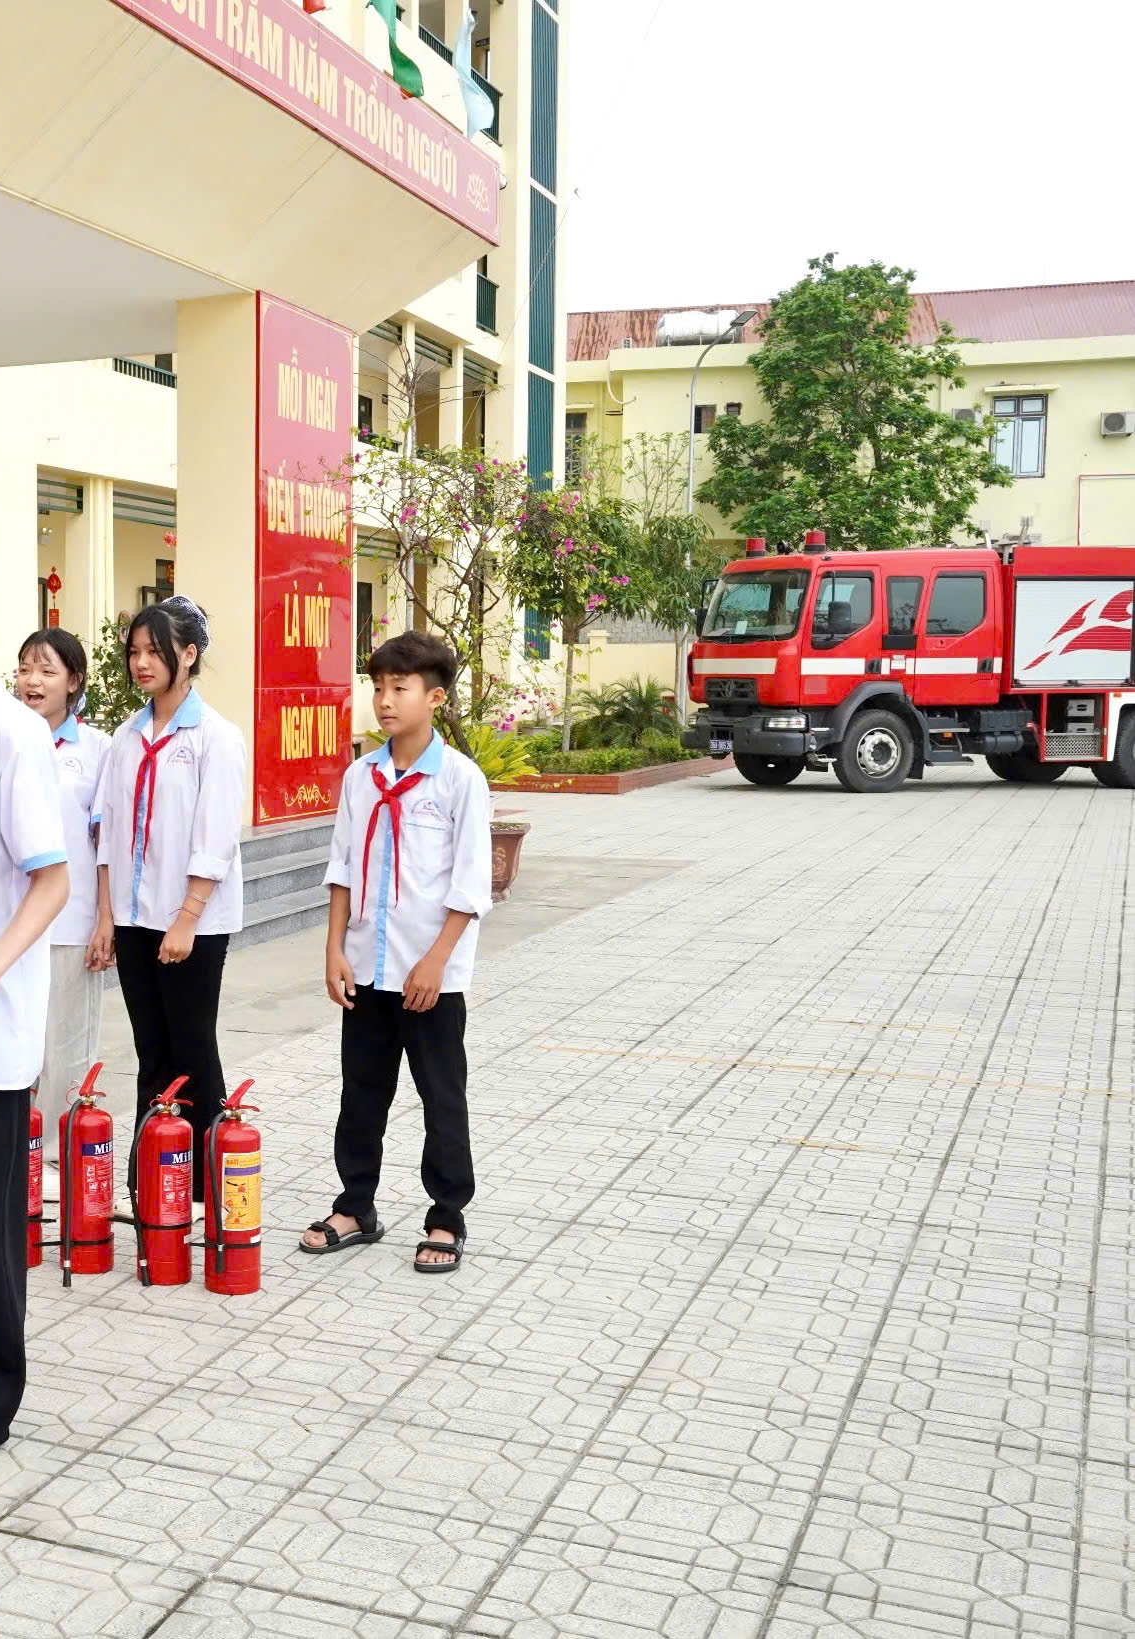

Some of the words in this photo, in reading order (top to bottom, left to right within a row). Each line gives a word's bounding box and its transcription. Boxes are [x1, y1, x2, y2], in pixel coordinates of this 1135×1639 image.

[288, 33, 339, 118] NĂM
[344, 76, 404, 160] TRỒNG
[407, 123, 458, 198] NGƯỜI
[277, 346, 303, 424] MỖI
[306, 366, 339, 433] NGÀY
[267, 459, 295, 535] ĐẾN
[284, 580, 301, 647] LÀ
[304, 582, 331, 660] MỘT
[281, 693, 314, 761] NGÀY
[317, 705, 337, 757] VUI
